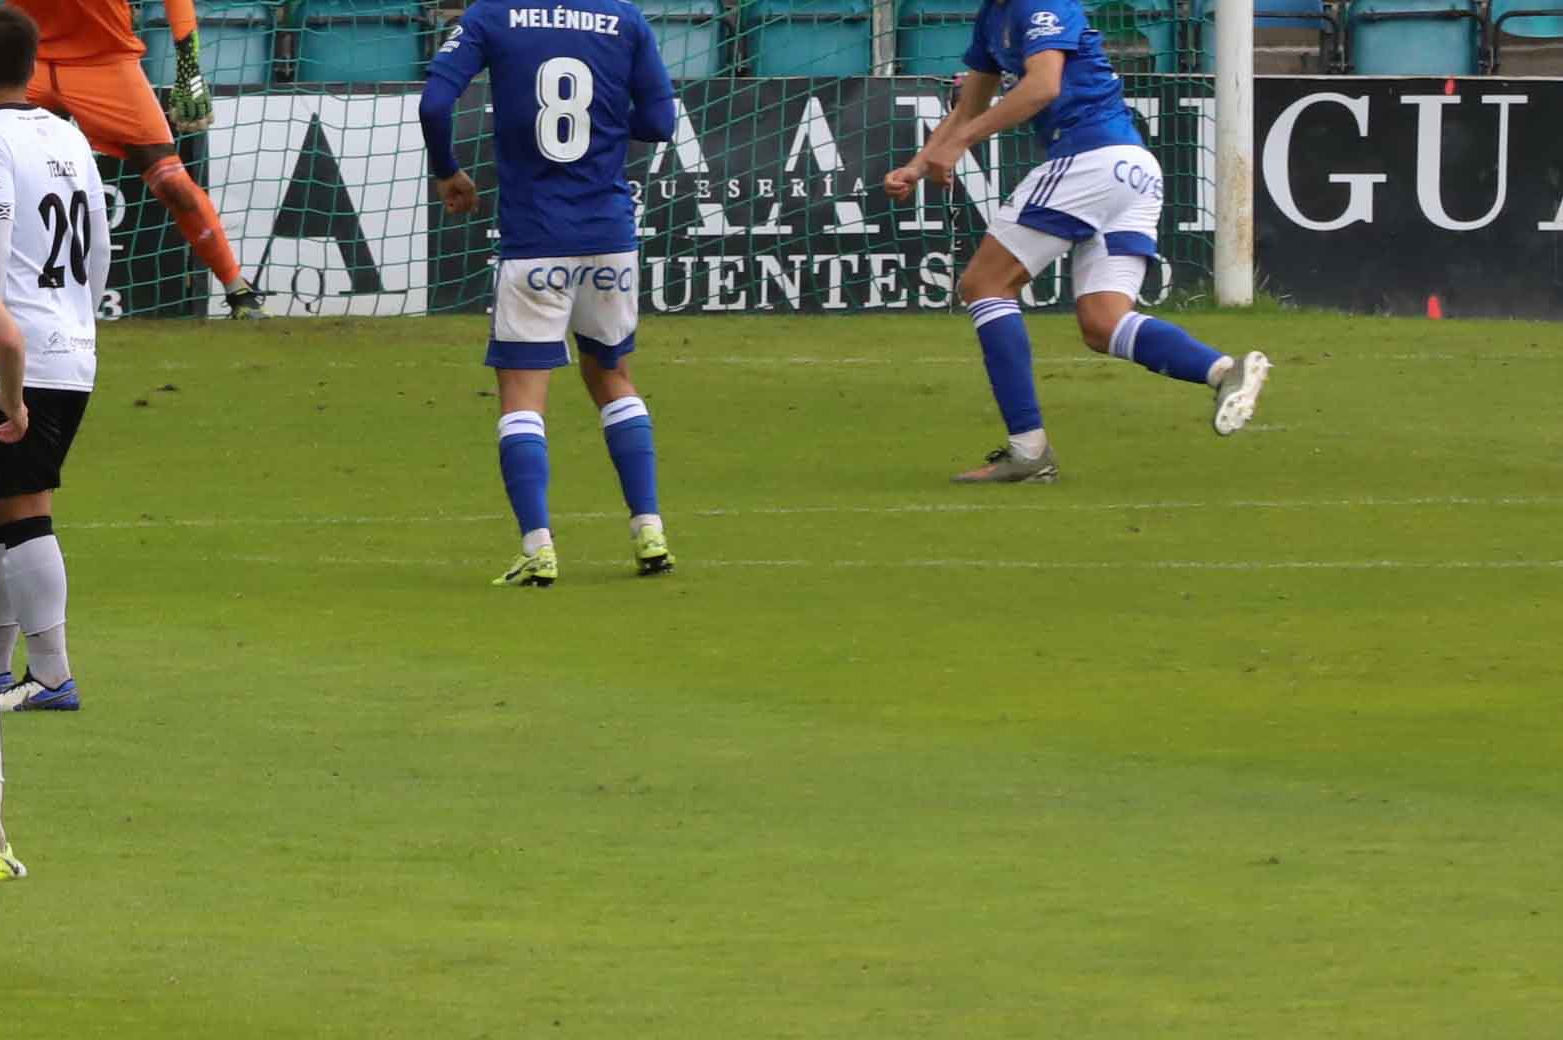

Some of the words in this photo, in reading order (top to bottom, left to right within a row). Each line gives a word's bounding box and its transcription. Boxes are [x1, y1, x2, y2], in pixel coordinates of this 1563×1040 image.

[509, 4, 621, 36] MELÉNDEZ
[536, 56, 594, 163] 8
[37, 189, 91, 290] 20
